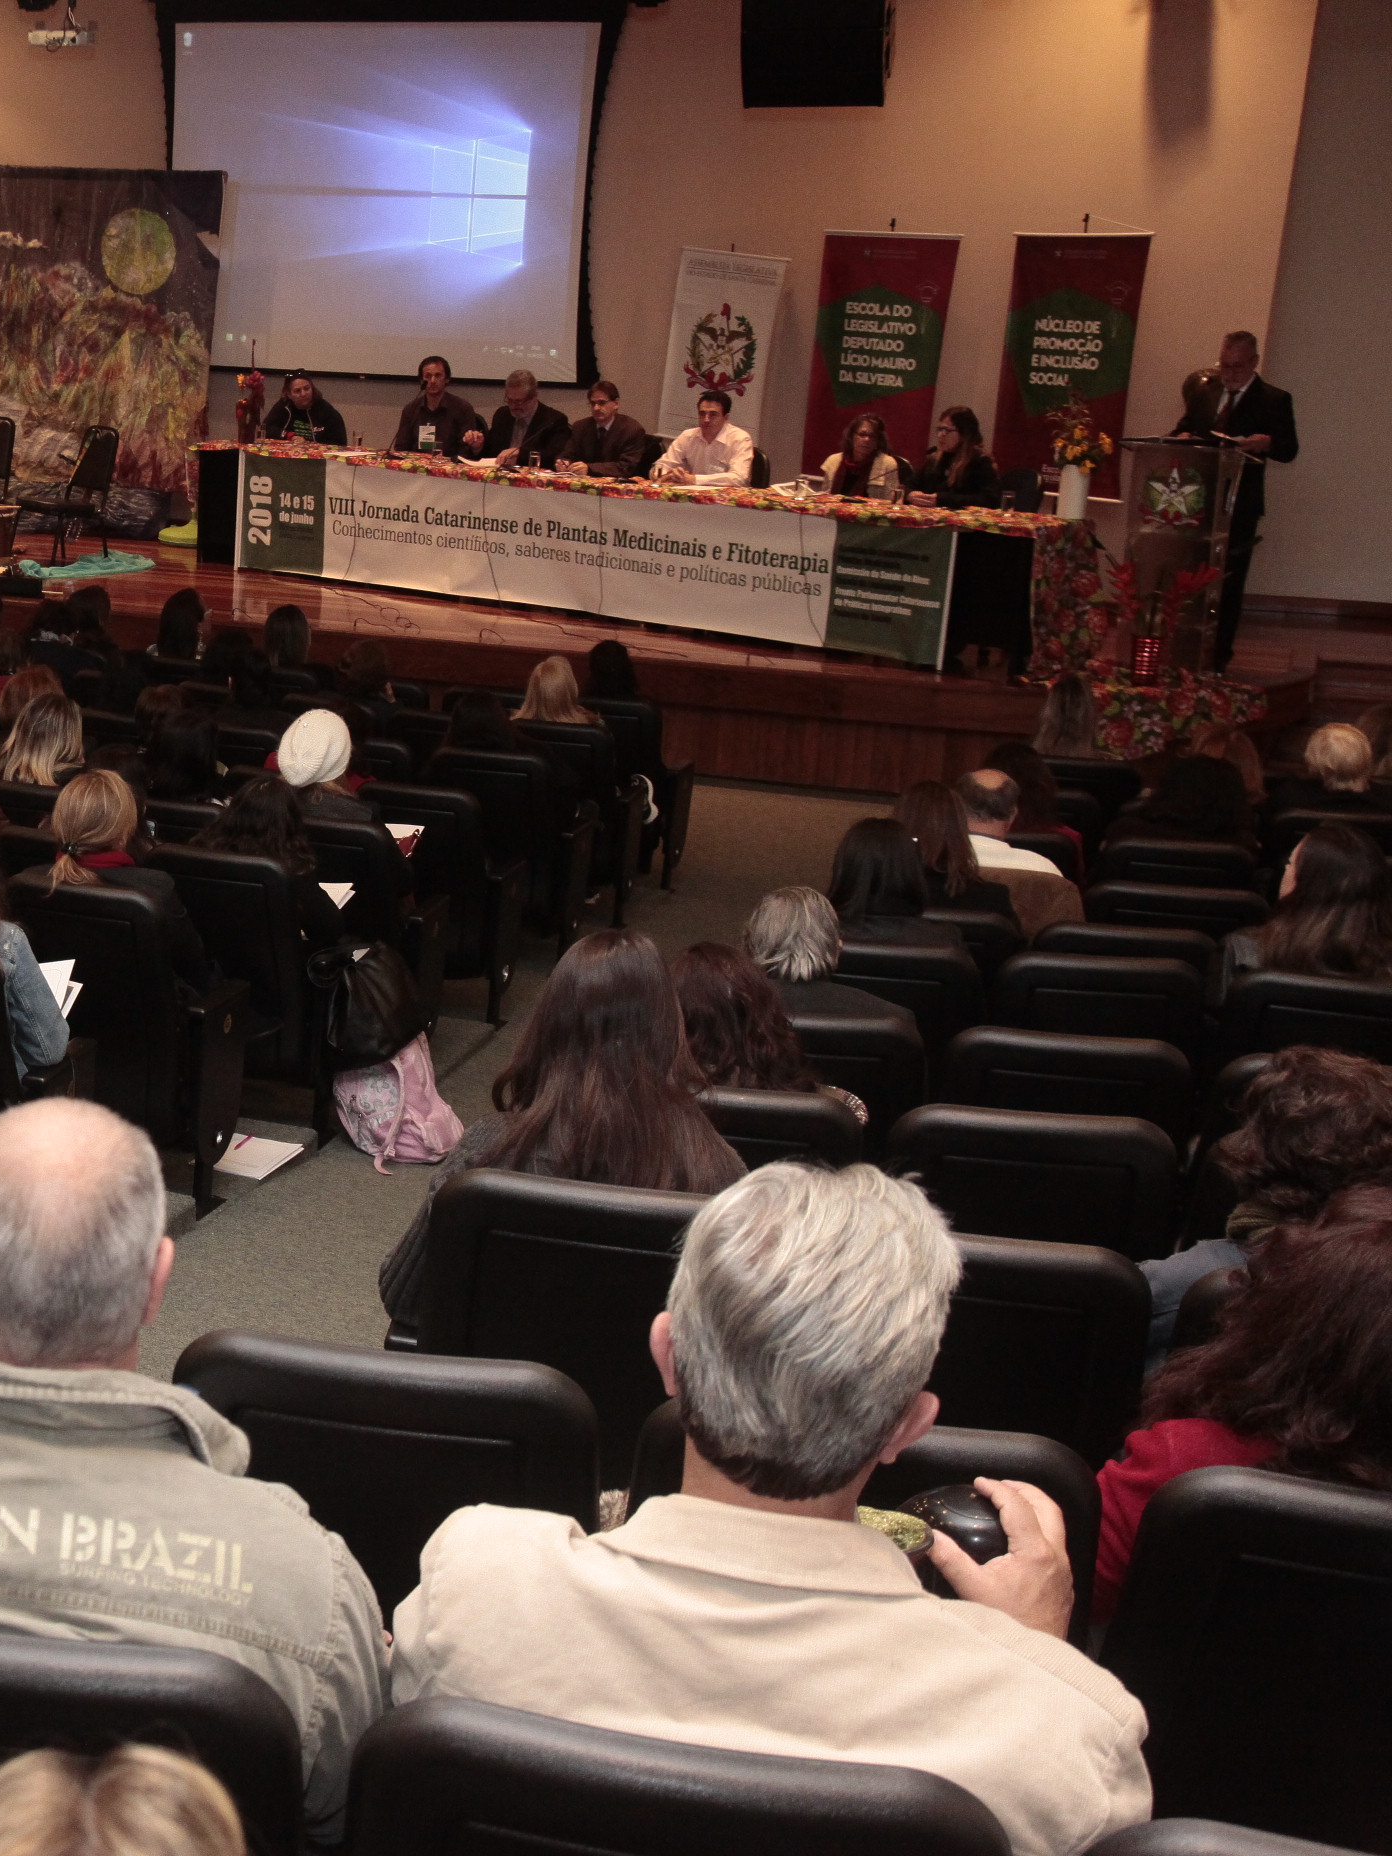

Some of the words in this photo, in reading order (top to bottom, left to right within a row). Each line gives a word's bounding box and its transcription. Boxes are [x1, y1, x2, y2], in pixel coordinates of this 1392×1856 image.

[845, 301, 891, 316] ESCOLA
[892, 304, 913, 317] DO
[843, 318, 917, 335] LEGISLATIVO
[1035, 315, 1084, 333] NÚCLEO
[1084, 320, 1102, 334] DE
[842, 336, 904, 352] DEPUTADO
[1032, 335, 1103, 355] PROMOÇÃO
[840, 350, 870, 366] LÍCIO
[871, 356, 917, 371] MAURO
[1031, 354, 1039, 367] E
[1040, 353, 1099, 370] INCLUSÃO
[839, 370, 854, 383] DA
[855, 371, 904, 387] SILVEIRA
[248, 474, 273, 547] 2018
[279, 492, 291, 508] 14
[293, 496, 300, 509] e
[302, 495, 315, 511] 15
[279, 511, 290, 522] de
[290, 512, 314, 525] junho
[328, 496, 356, 517] VIII
[359, 500, 420, 525] Jornada
[423, 507, 518, 535] Catarinense
[523, 518, 543, 538] de
[546, 520, 608, 546] Plantas
[613, 529, 707, 559] Medicinais
[711, 543, 723, 561] e
[727, 541, 829, 576] Fitoterapia
[332, 519, 433, 547] Conhecimentos
[436, 528, 510, 558] científicos,
[514, 541, 571, 564] saberes
[574, 547, 663, 576] tradicionais
[666, 564, 676, 578] e
[678, 561, 747, 588] políticas
[751, 572, 822, 597] públicas
[59, 1512, 254, 1594] BRAZIL
